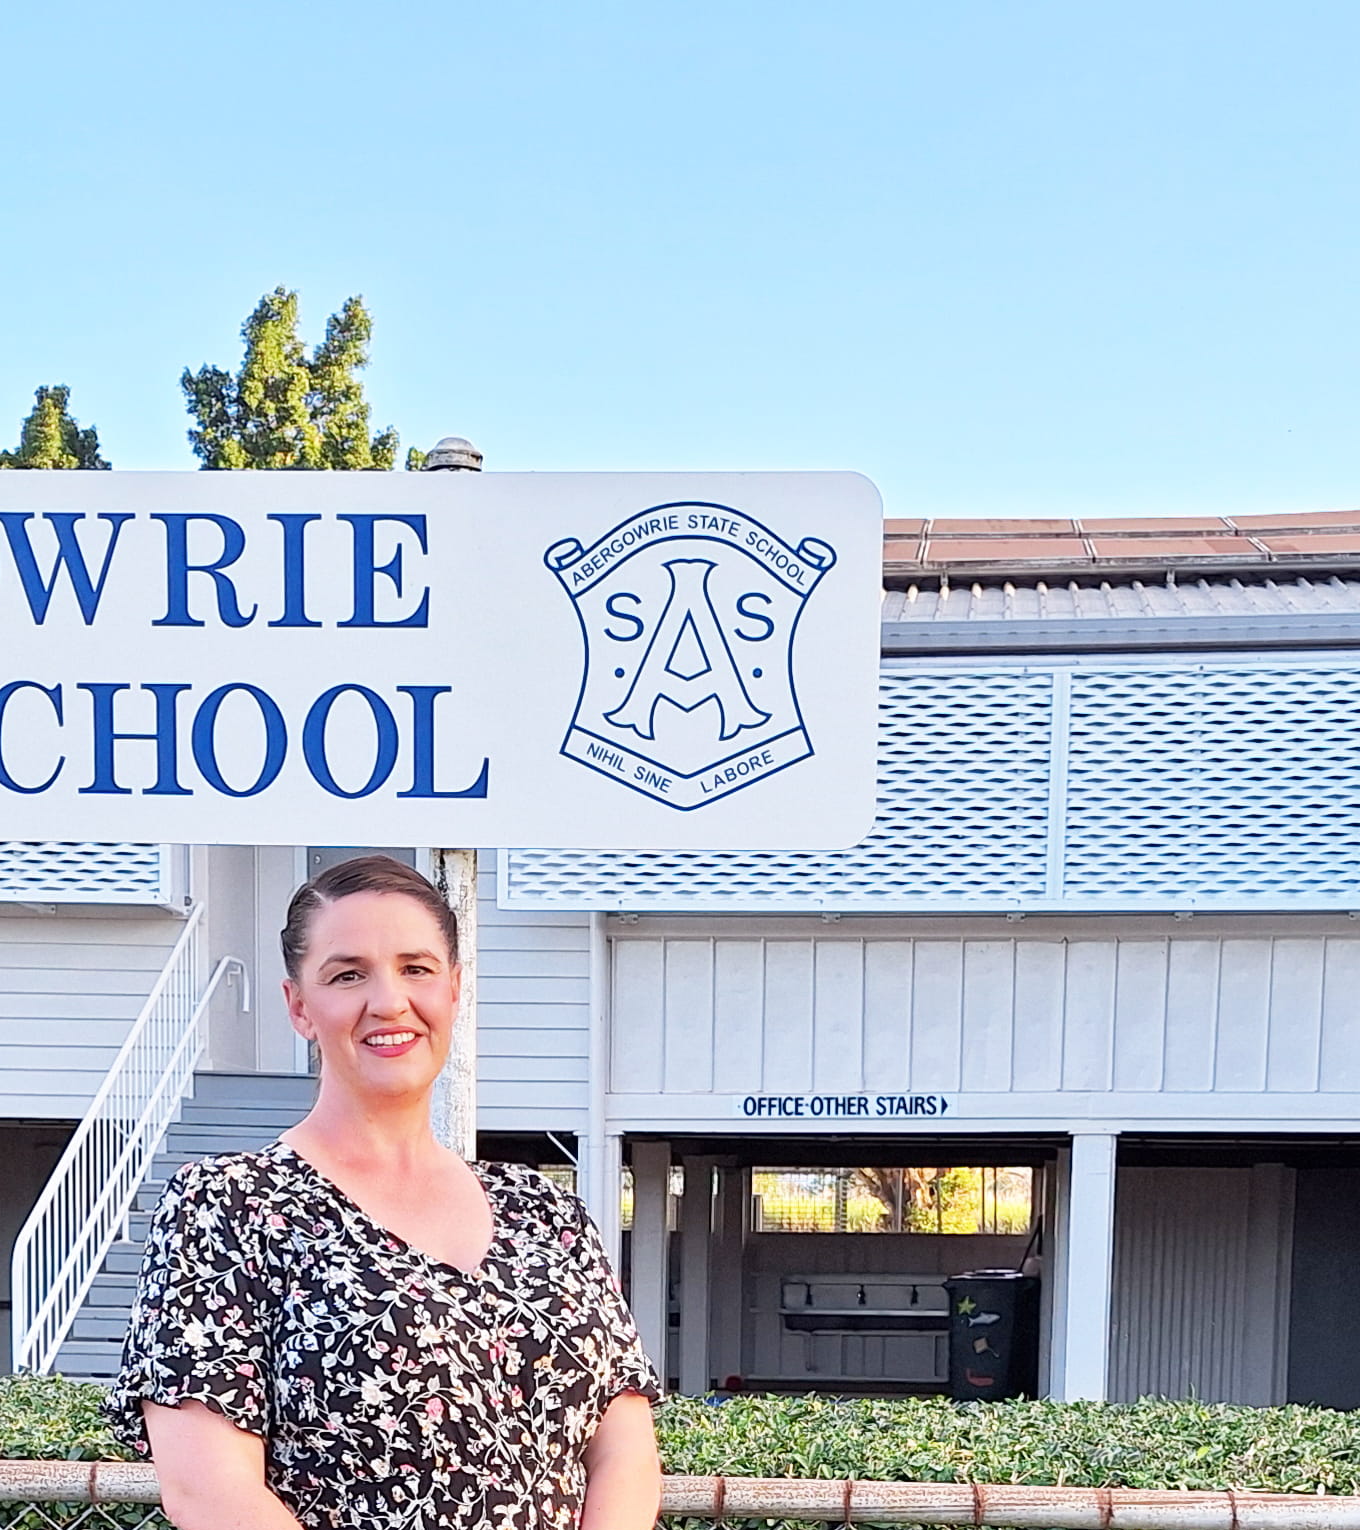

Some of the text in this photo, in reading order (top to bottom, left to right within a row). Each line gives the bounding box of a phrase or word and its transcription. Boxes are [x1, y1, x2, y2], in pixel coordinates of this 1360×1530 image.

[571, 513, 806, 587] ABERGOWRIE STATE SCHOOL
[603, 591, 645, 642] S
[733, 591, 775, 642] S
[585, 742, 775, 795] NIHIL SINE LABORE
[743, 1095, 937, 1117] OFFICE OTHER STAIRS
